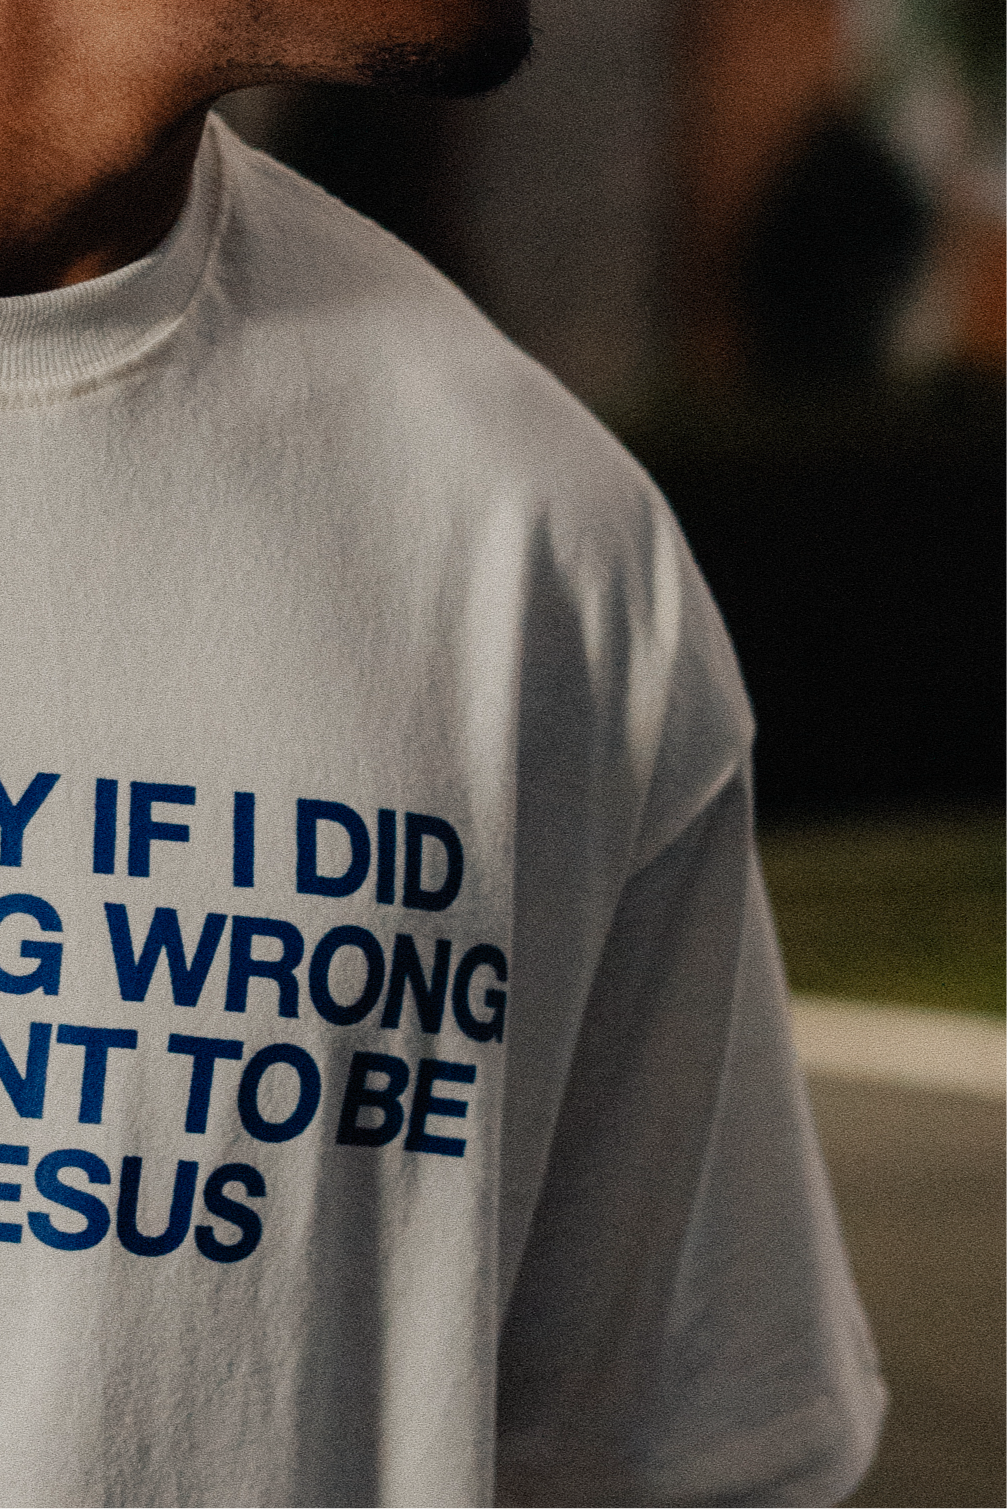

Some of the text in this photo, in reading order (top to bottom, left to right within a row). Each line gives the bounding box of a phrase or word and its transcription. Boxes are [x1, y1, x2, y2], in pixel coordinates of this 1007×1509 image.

[92, 777, 198, 879] IF
[232, 791, 257, 889] I
[296, 798, 465, 912] DID
[104, 902, 509, 1043] WRONG
[167, 1033, 322, 1144] TO
[336, 1050, 477, 1157] BE
